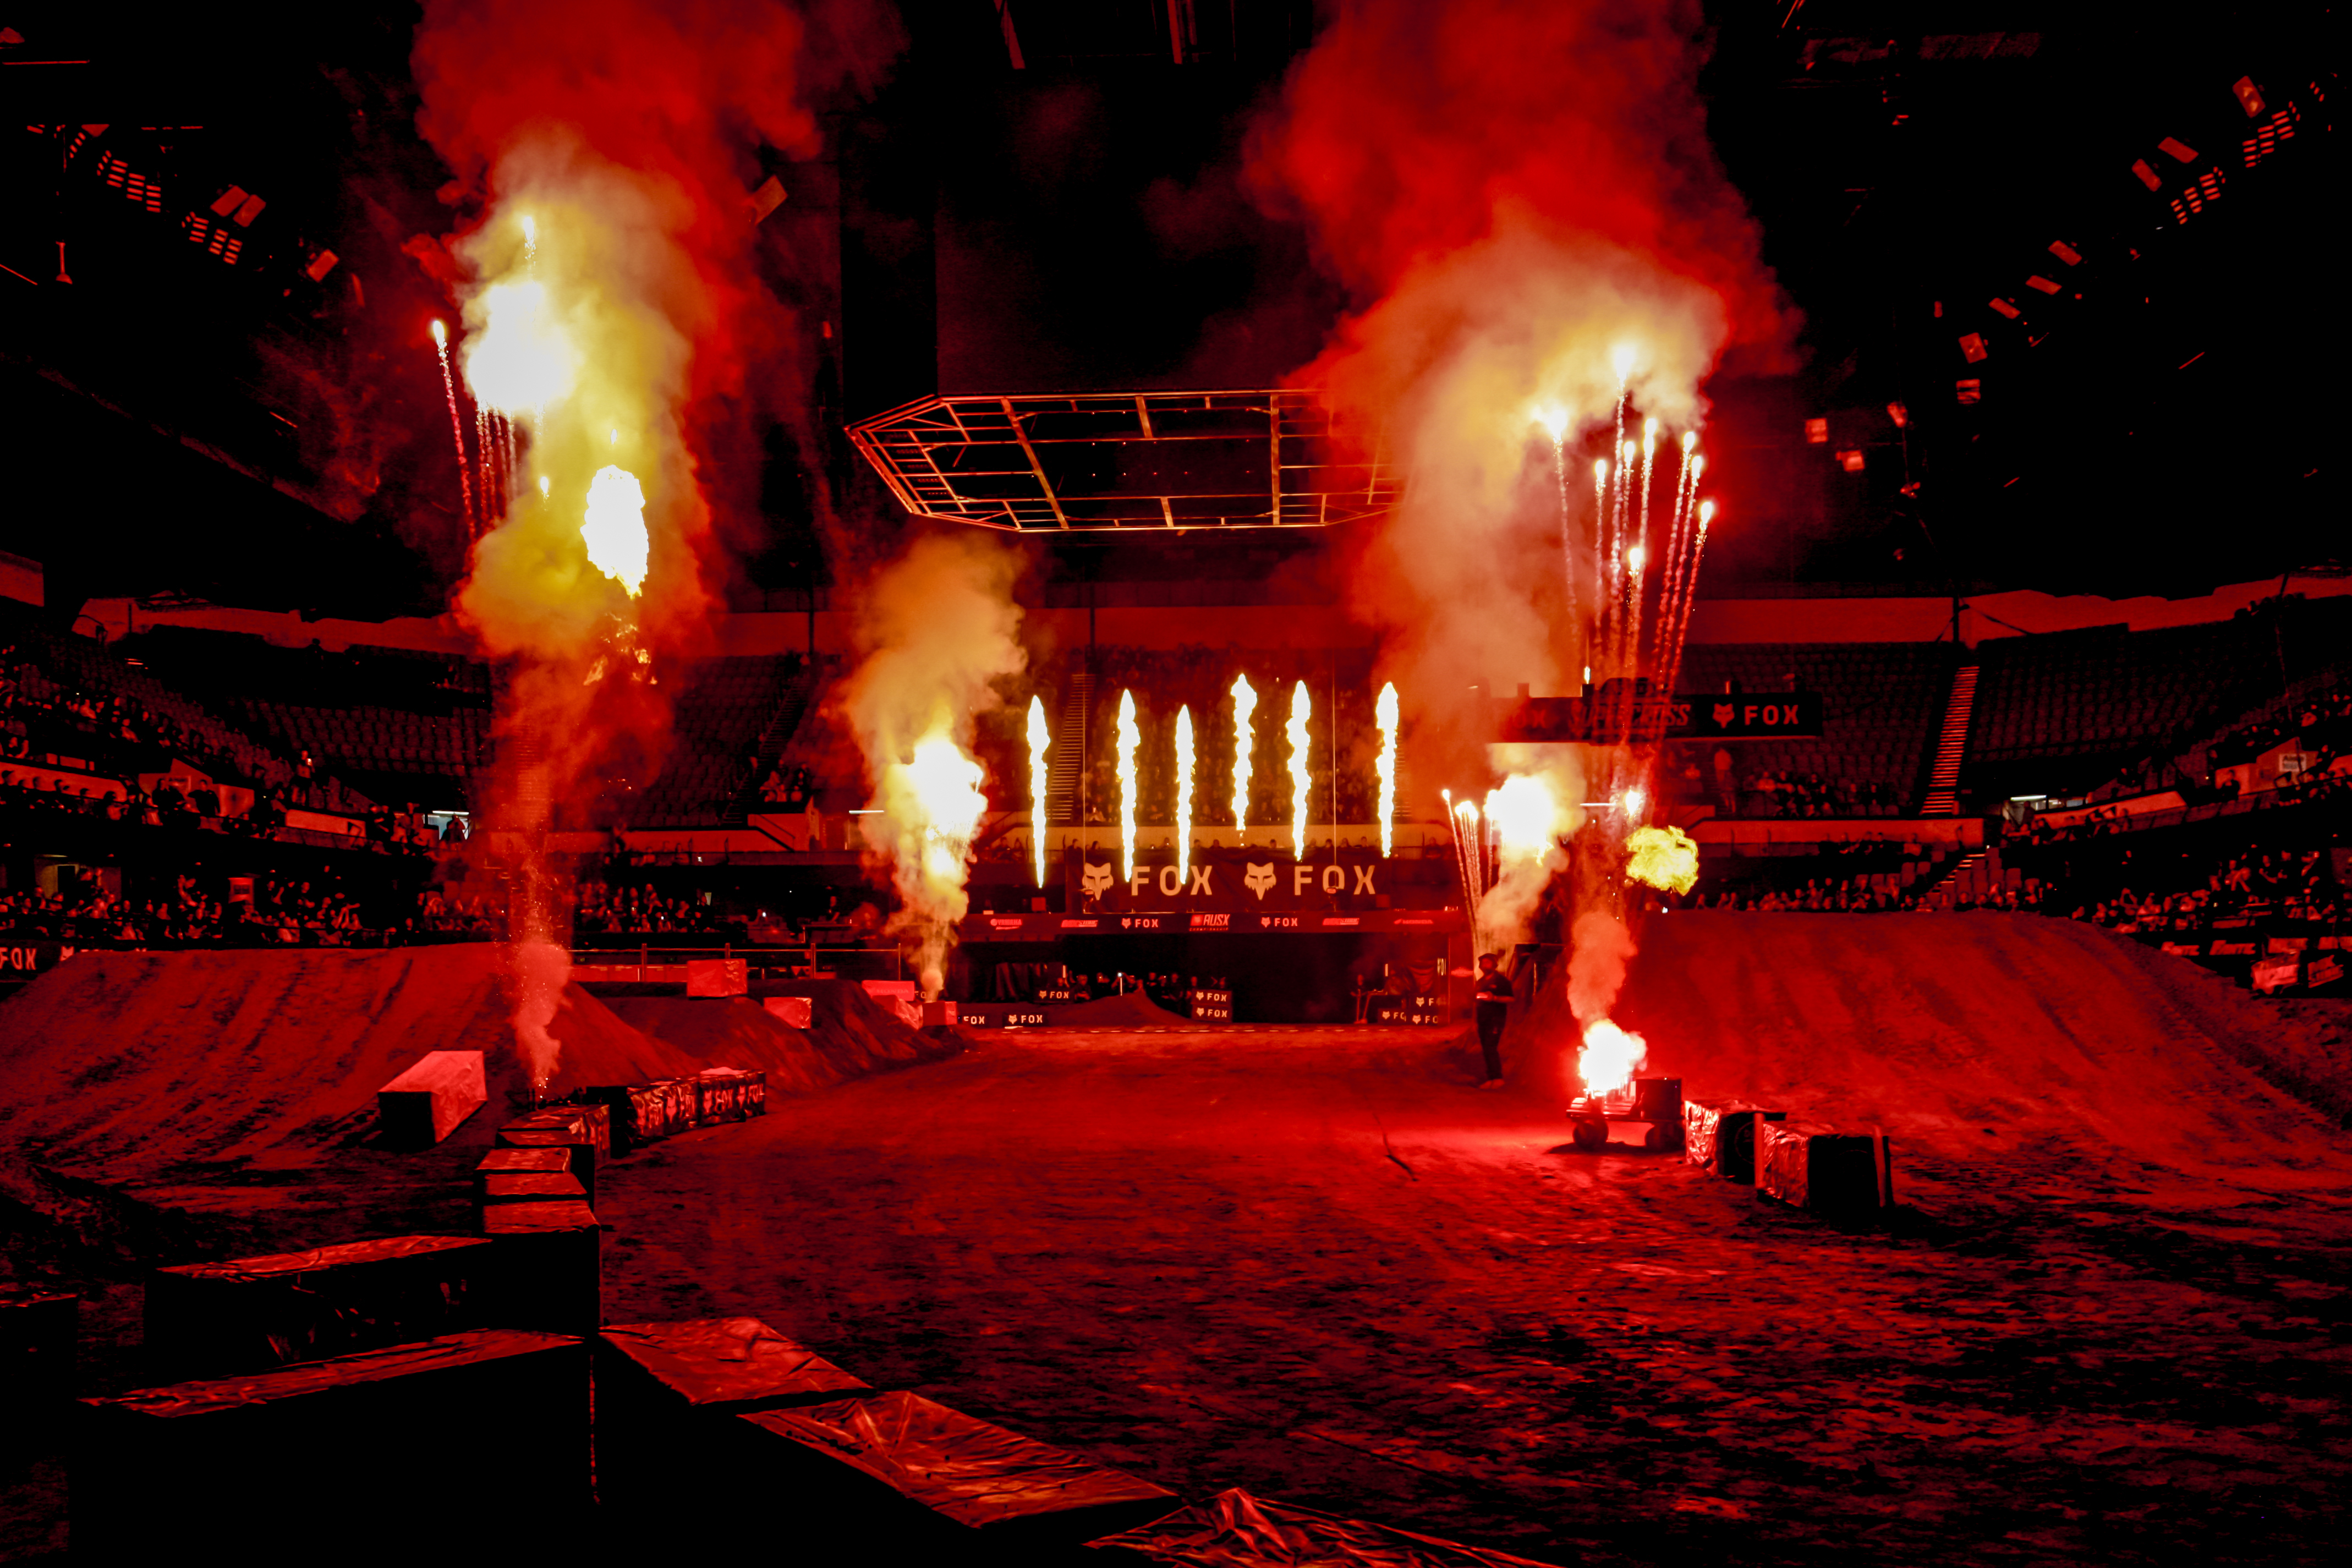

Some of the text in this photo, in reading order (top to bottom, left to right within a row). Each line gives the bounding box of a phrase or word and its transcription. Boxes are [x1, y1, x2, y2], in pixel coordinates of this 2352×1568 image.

[1569, 704, 1691, 726] SUPCROSS
[1745, 704, 1799, 726] FOX
[1131, 865, 1213, 896] FOX
[1295, 865, 1376, 896] FOX
[1135, 918, 1159, 928] FOX
[1203, 914, 1230, 926] AUSX
[1274, 918, 1298, 927] FOX
[0, 947, 36, 970] FOX
[1207, 993, 1227, 1001] FOX
[1208, 1008, 1227, 1017] FOX
[1021, 1015, 1043, 1023] FOX
